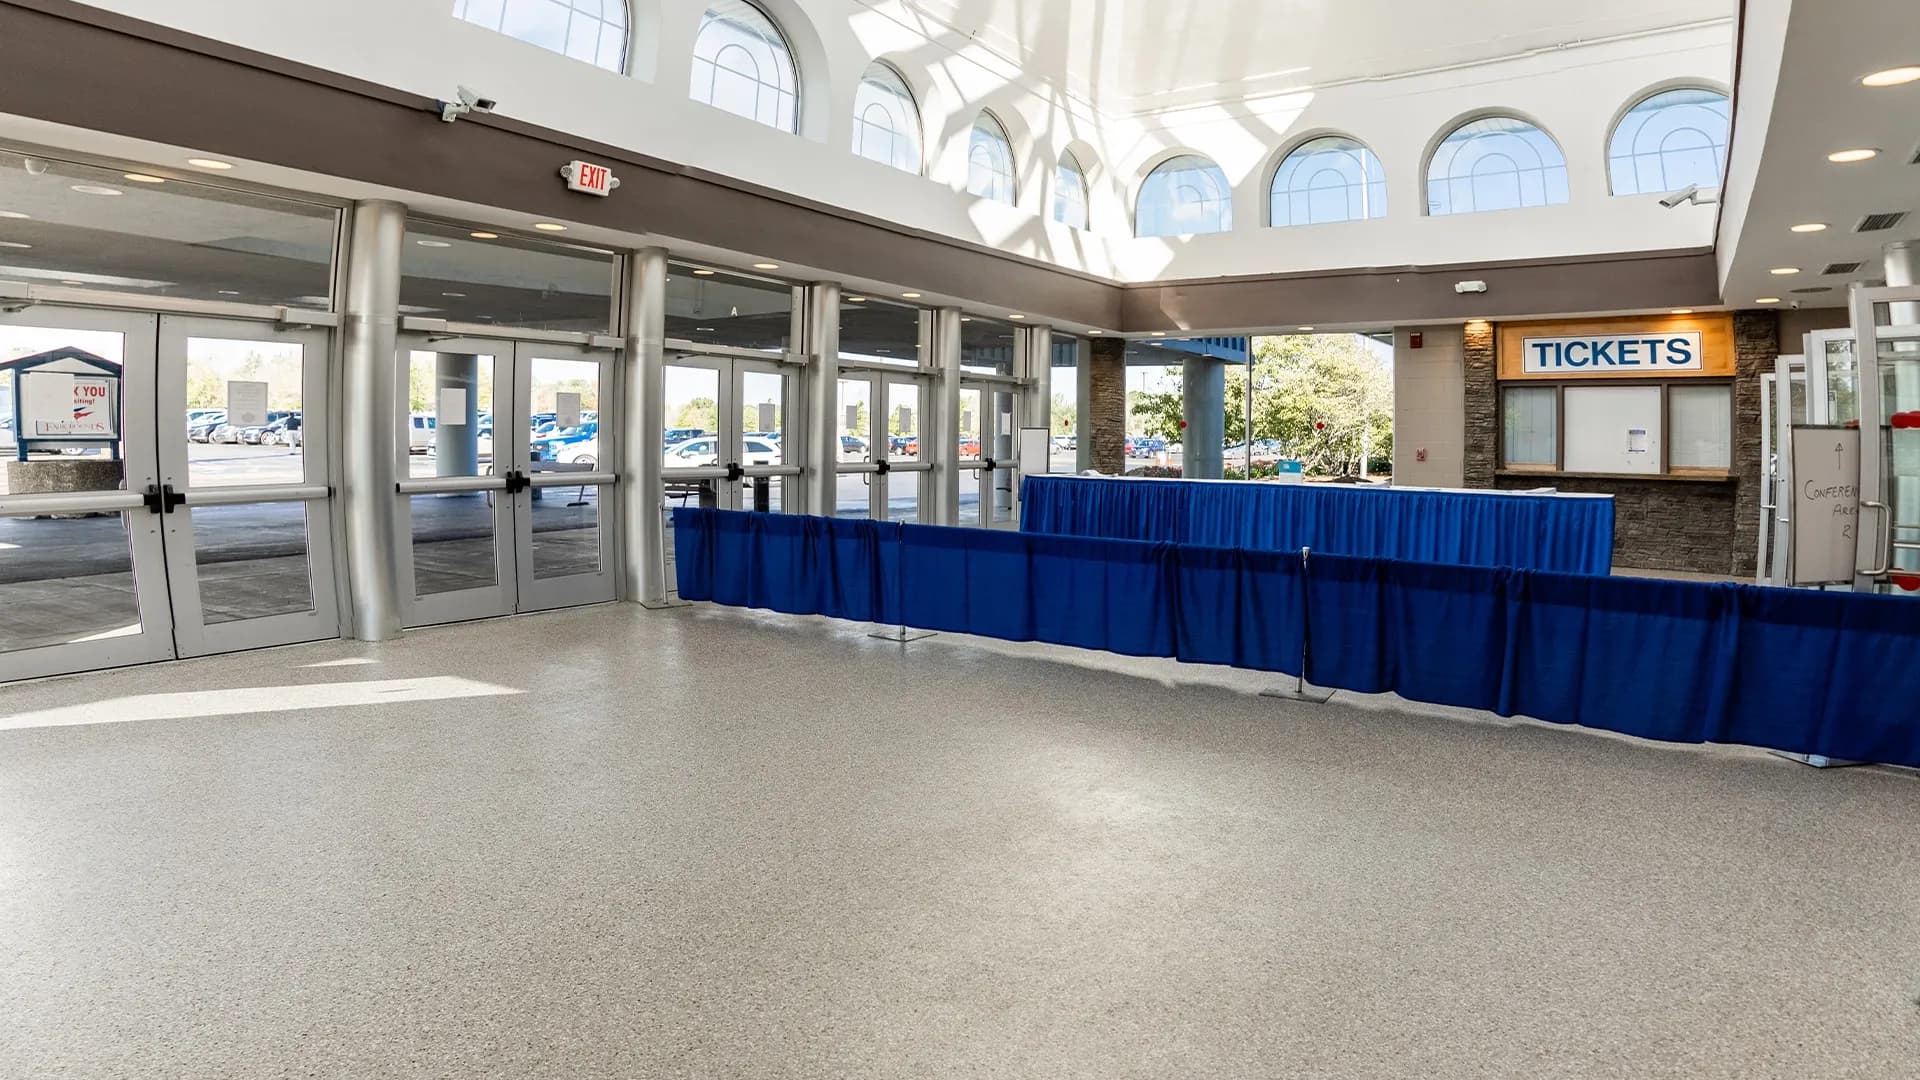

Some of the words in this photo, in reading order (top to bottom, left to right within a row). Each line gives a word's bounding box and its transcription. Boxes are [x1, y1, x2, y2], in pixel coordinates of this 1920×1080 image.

[580, 164, 608, 191] EXIT
[731, 306, 738, 317] A
[1532, 338, 1692, 367] TICKETS
[83, 386, 106, 397] YOU
